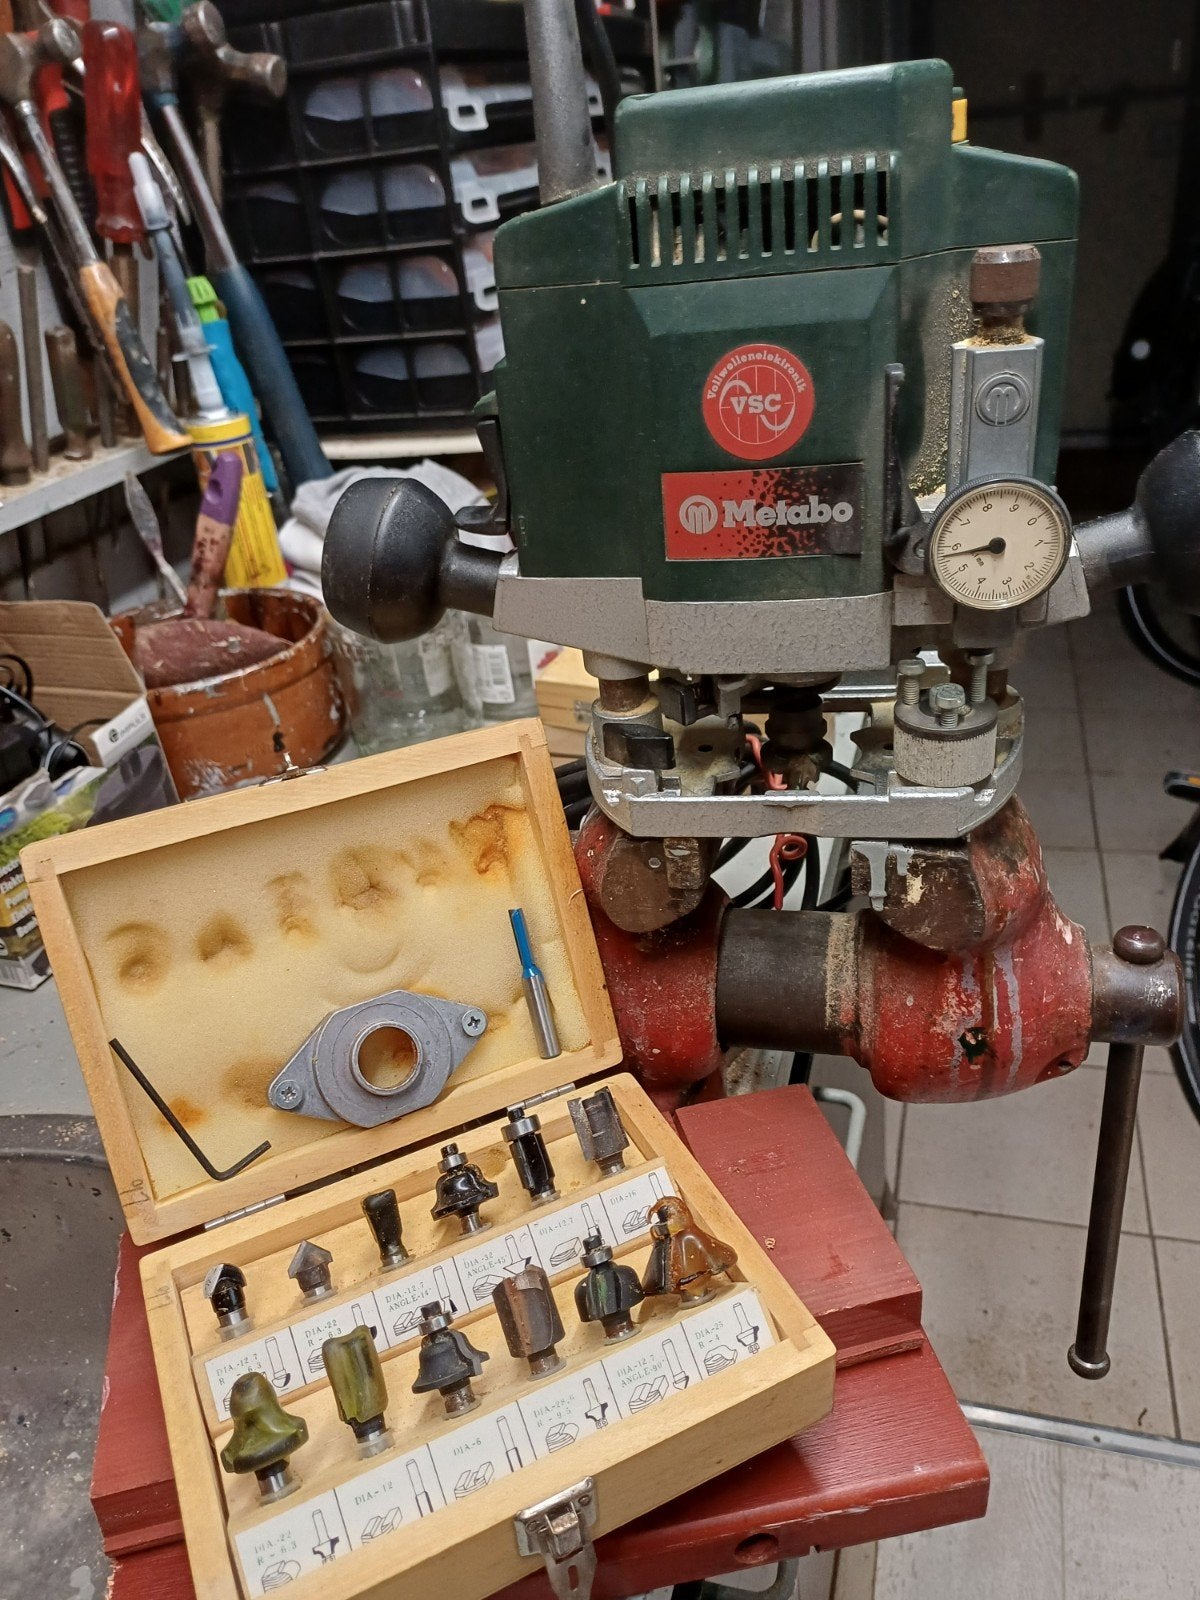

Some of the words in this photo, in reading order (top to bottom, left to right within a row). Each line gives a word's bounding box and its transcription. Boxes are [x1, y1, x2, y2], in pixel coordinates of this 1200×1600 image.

[707, 350, 807, 400] Vollwellenelektronik
[730, 393, 782, 415] VSC
[722, 495, 854, 528] Metabo
[982, 502, 993, 513] 8
[1008, 503, 1020, 514] 9
[960, 518, 971, 527] 7
[1027, 517, 1038, 527] 0
[951, 542, 962, 551] 6
[1034, 539, 1044, 547] 1
[958, 563, 969, 572] 5
[1024, 561, 1035, 571] 2
[976, 577, 987, 585] 4
[1001, 576, 1012, 586] 3
